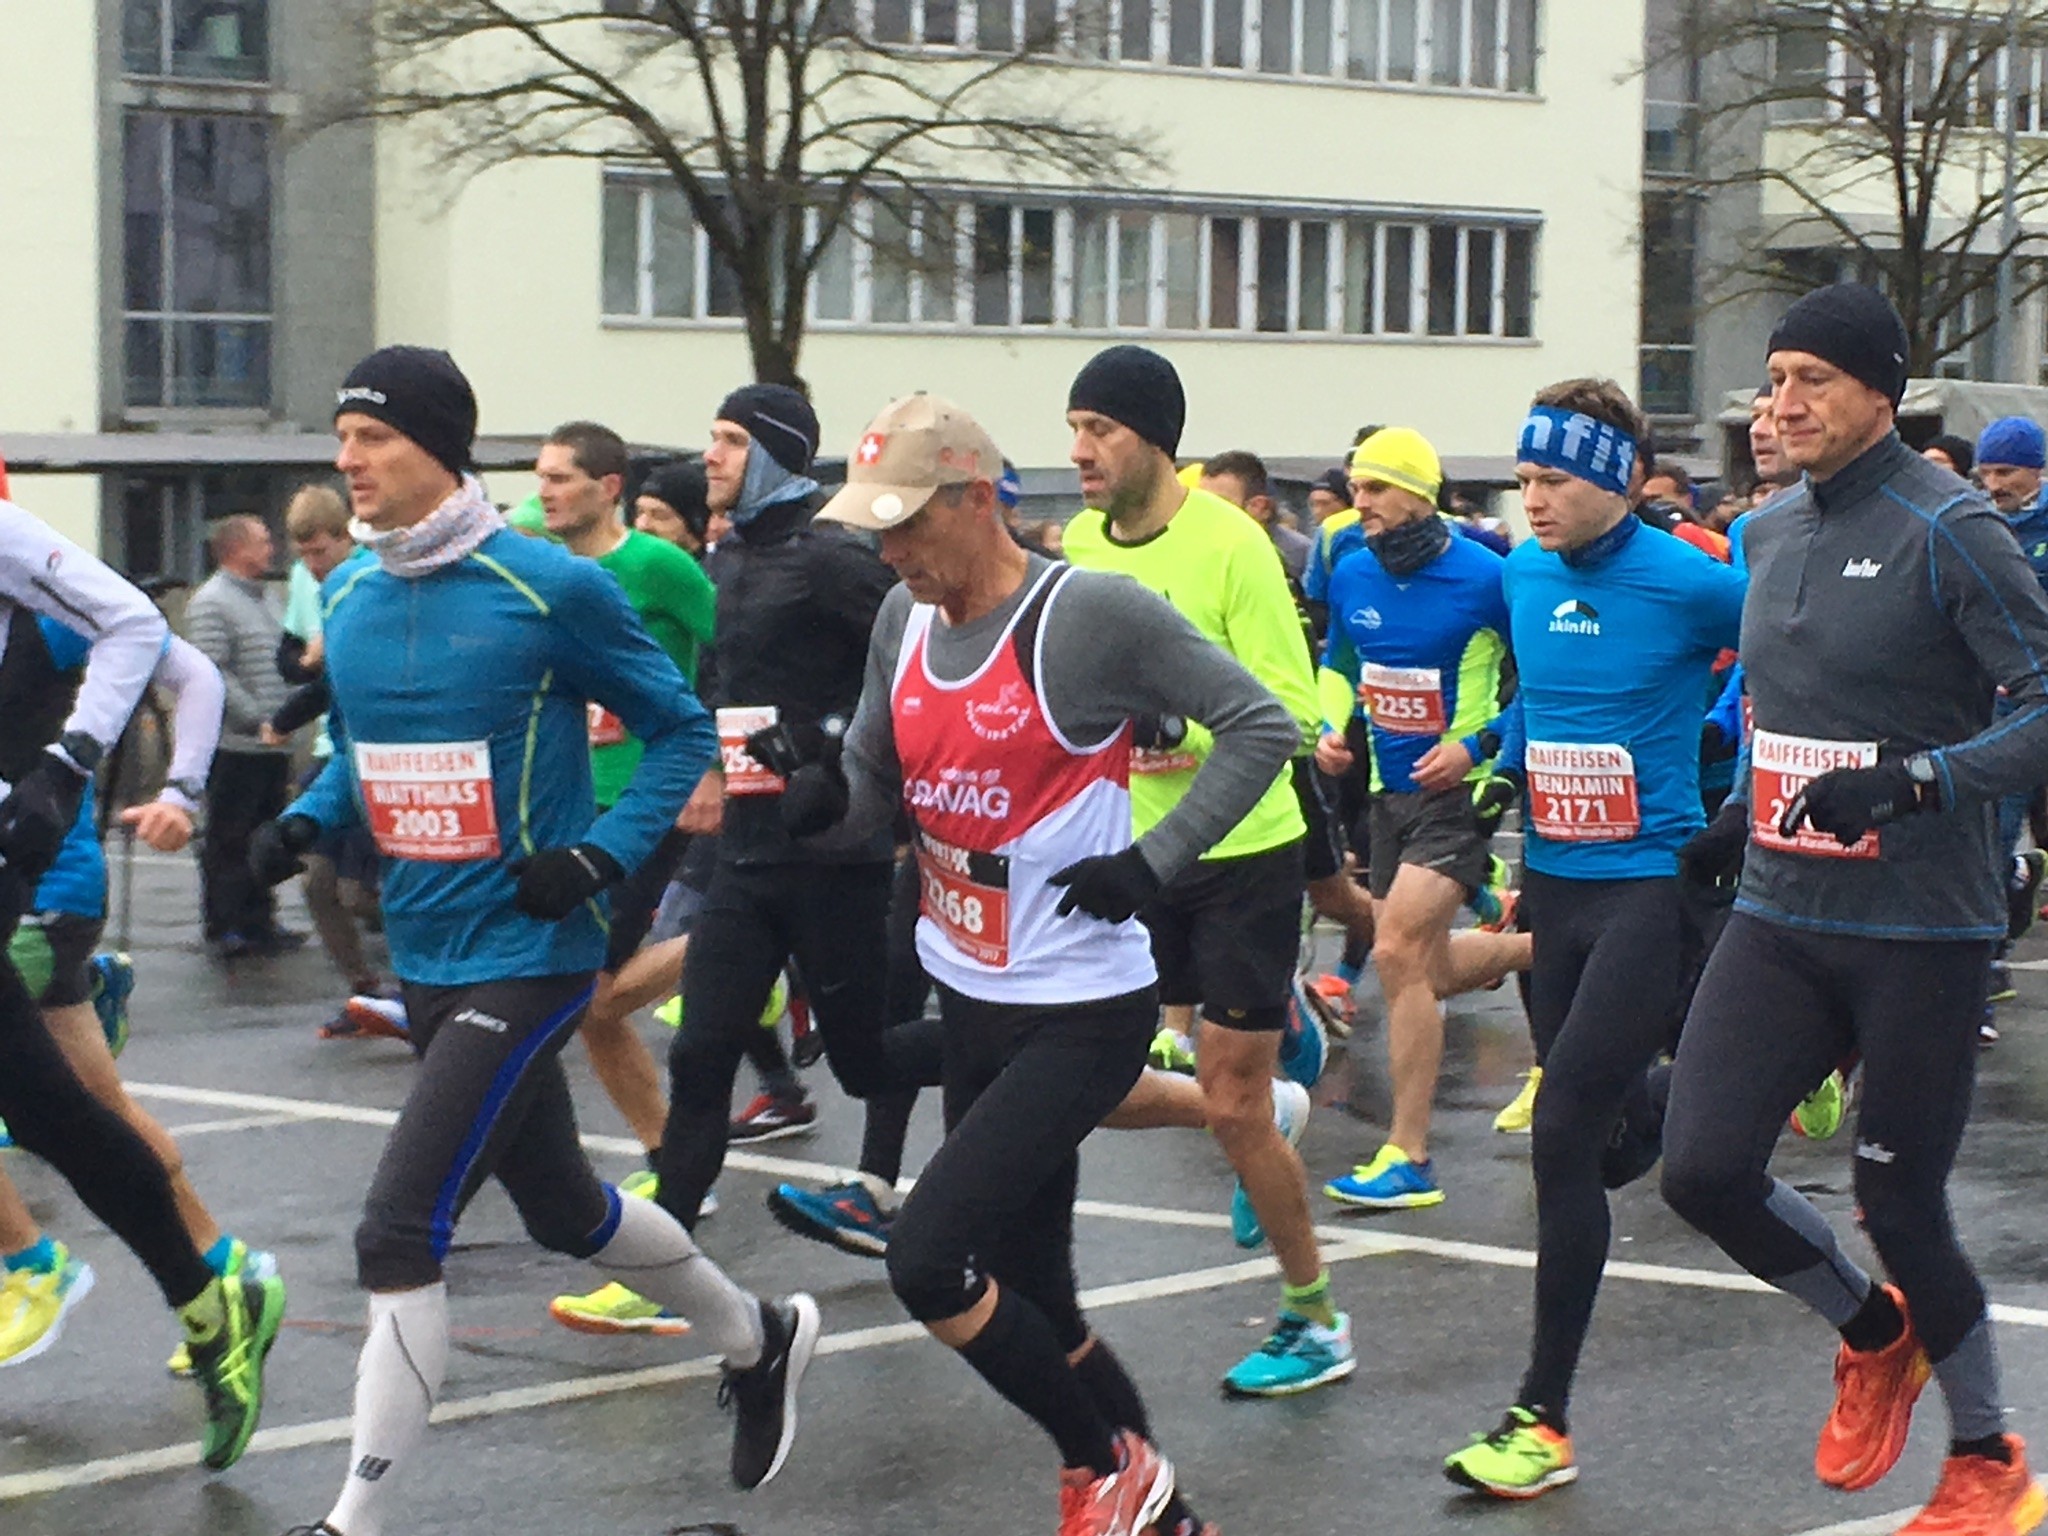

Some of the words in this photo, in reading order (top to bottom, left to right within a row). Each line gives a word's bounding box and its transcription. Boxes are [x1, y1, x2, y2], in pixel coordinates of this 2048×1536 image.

[1373, 692, 1428, 720] 2255
[1529, 746, 1622, 768] RAIFFEISEN
[1758, 738, 1862, 769] RAIFFEISEN
[1534, 773, 1626, 796] BENJAMIN
[388, 808, 463, 838] 2003
[1545, 796, 1608, 825] 2171
